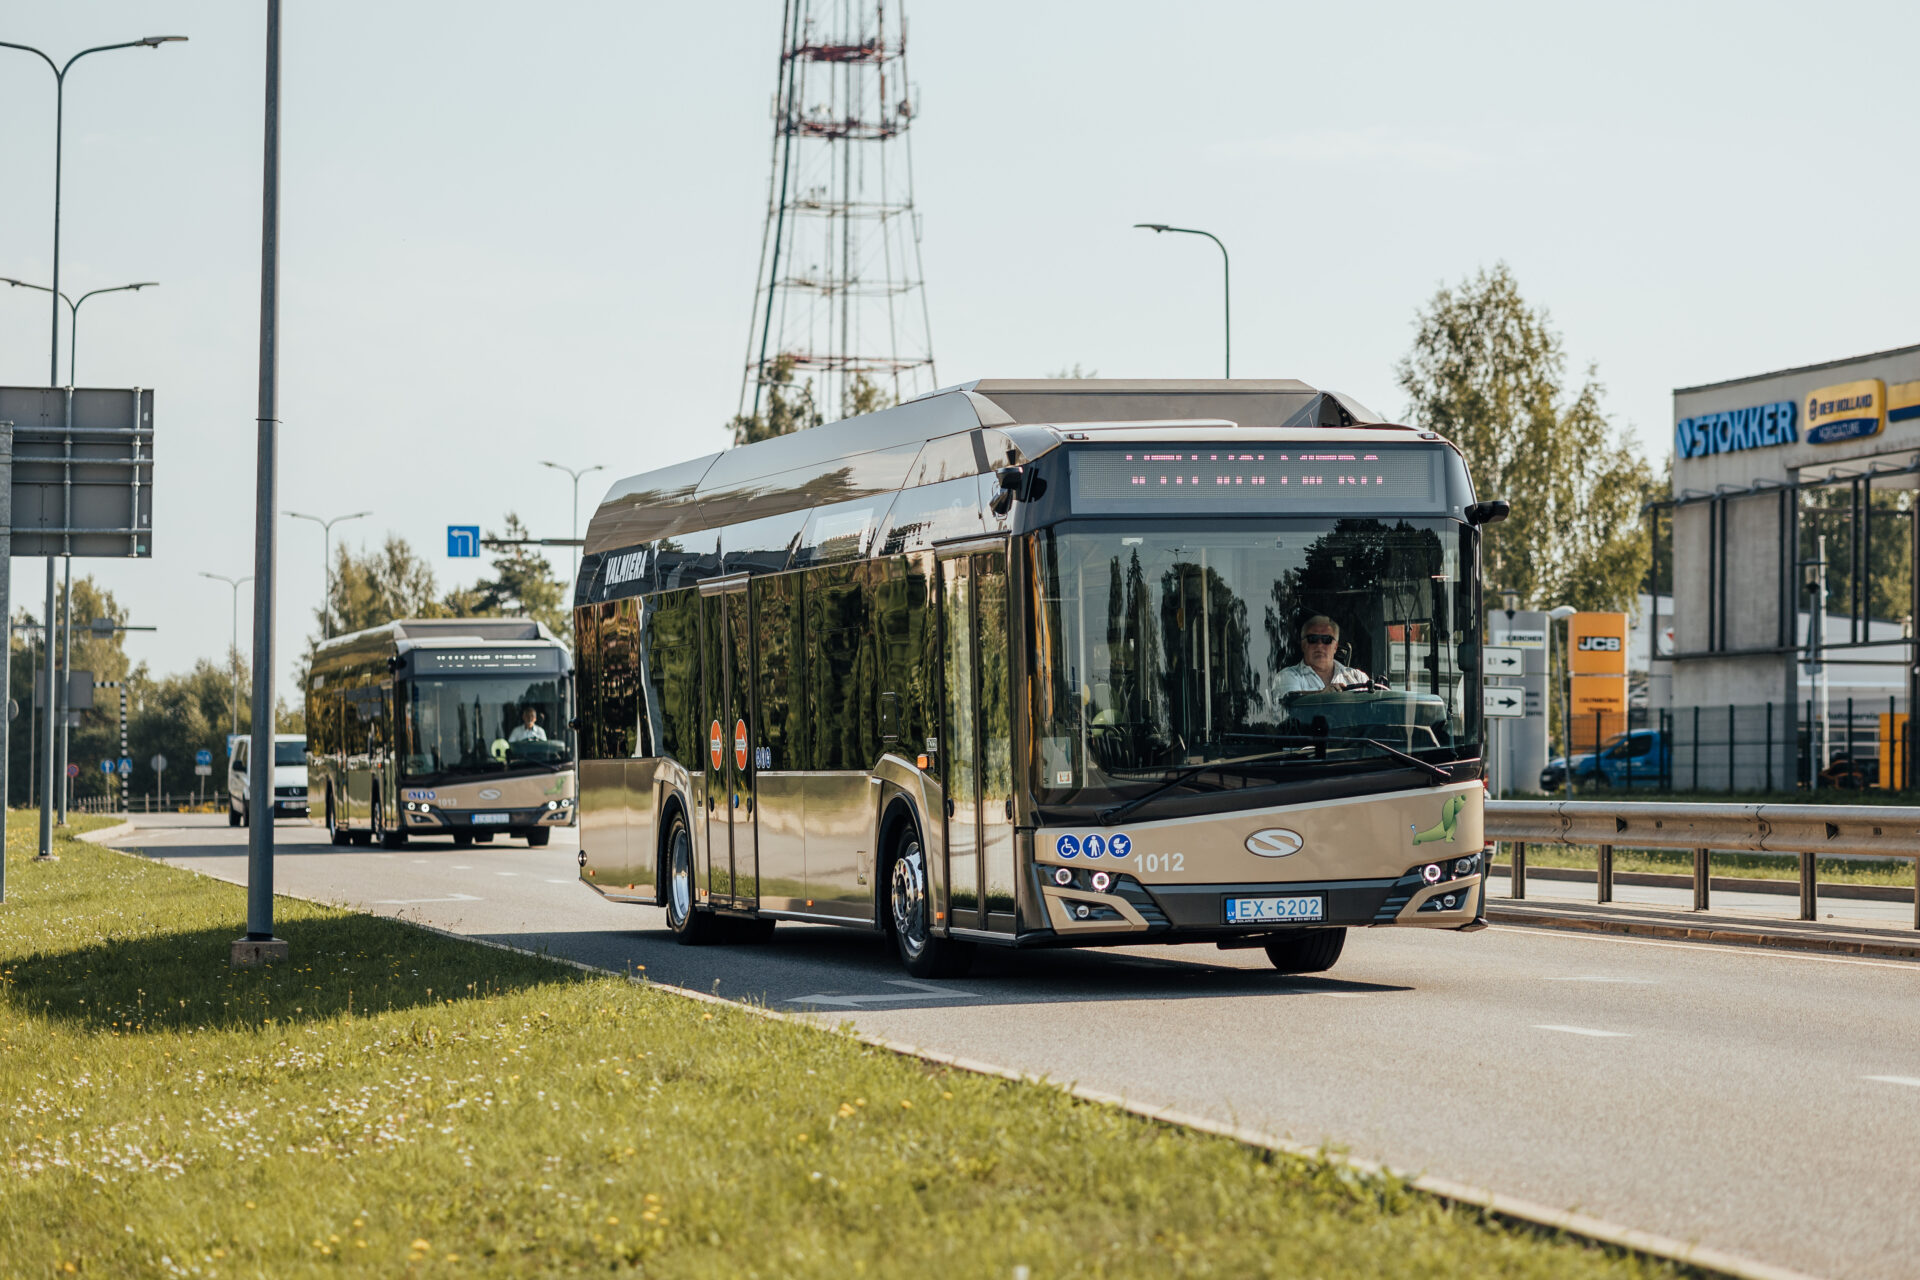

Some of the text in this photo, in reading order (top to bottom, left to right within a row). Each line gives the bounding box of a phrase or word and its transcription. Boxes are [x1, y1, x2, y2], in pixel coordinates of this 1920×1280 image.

[1837, 394, 1872, 412] HOLLAND
[1692, 402, 1796, 455] STOKKER
[605, 550, 648, 586] VALMIERA
[1578, 637, 1620, 651] JCB
[1134, 852, 1185, 873] 1012
[1240, 899, 1319, 917] EX-6202
